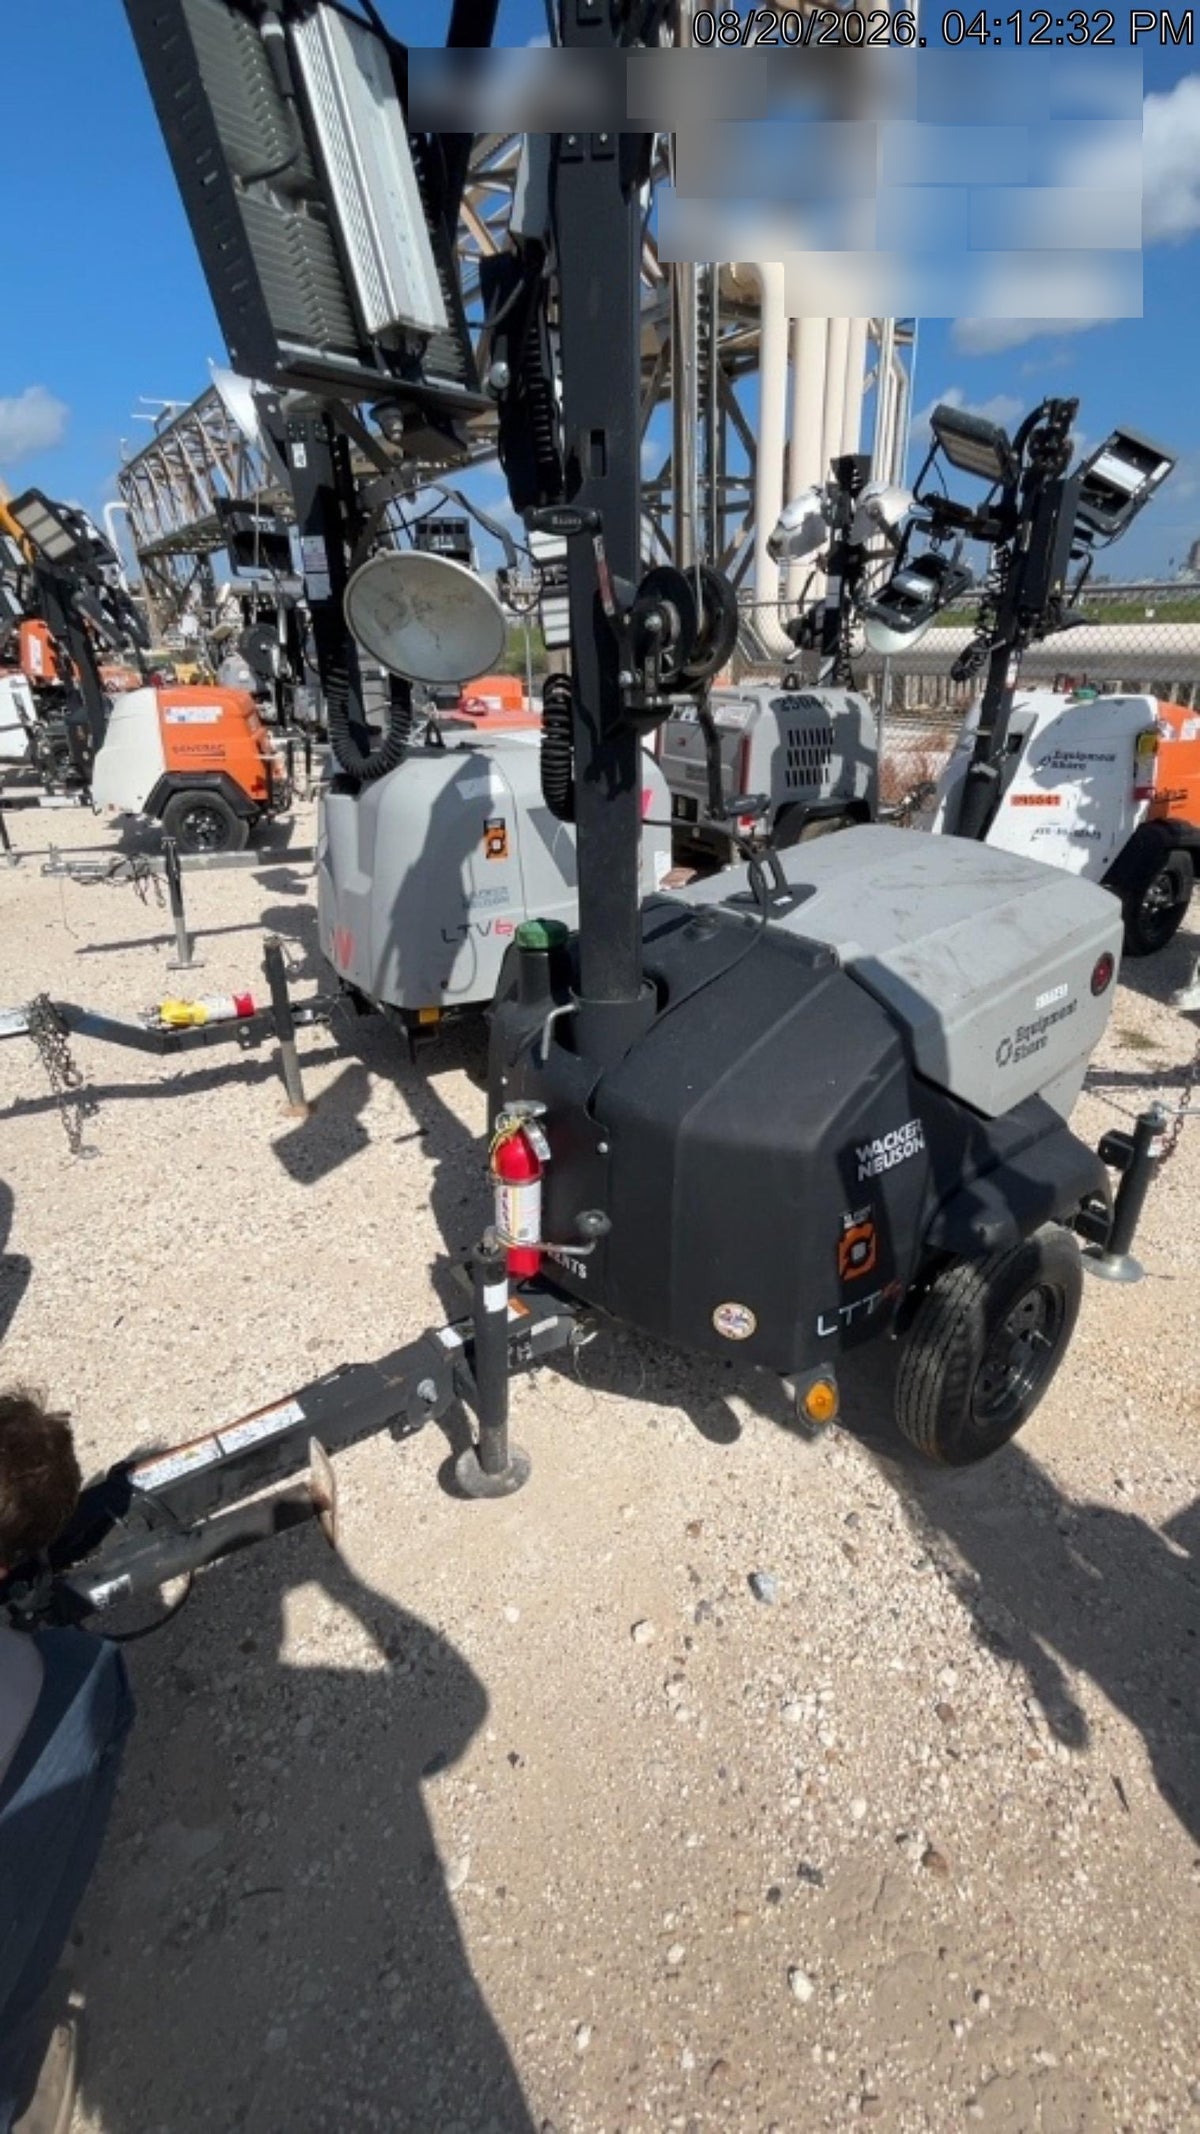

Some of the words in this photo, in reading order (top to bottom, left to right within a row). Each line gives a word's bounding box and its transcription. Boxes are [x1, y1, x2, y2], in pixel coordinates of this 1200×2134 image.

[1015, 998, 1077, 1043] Equipment
[1013, 1035, 1048, 1063] Share
[855, 1118, 923, 1163] WACKER
[857, 1132, 926, 1182] NEUSON
